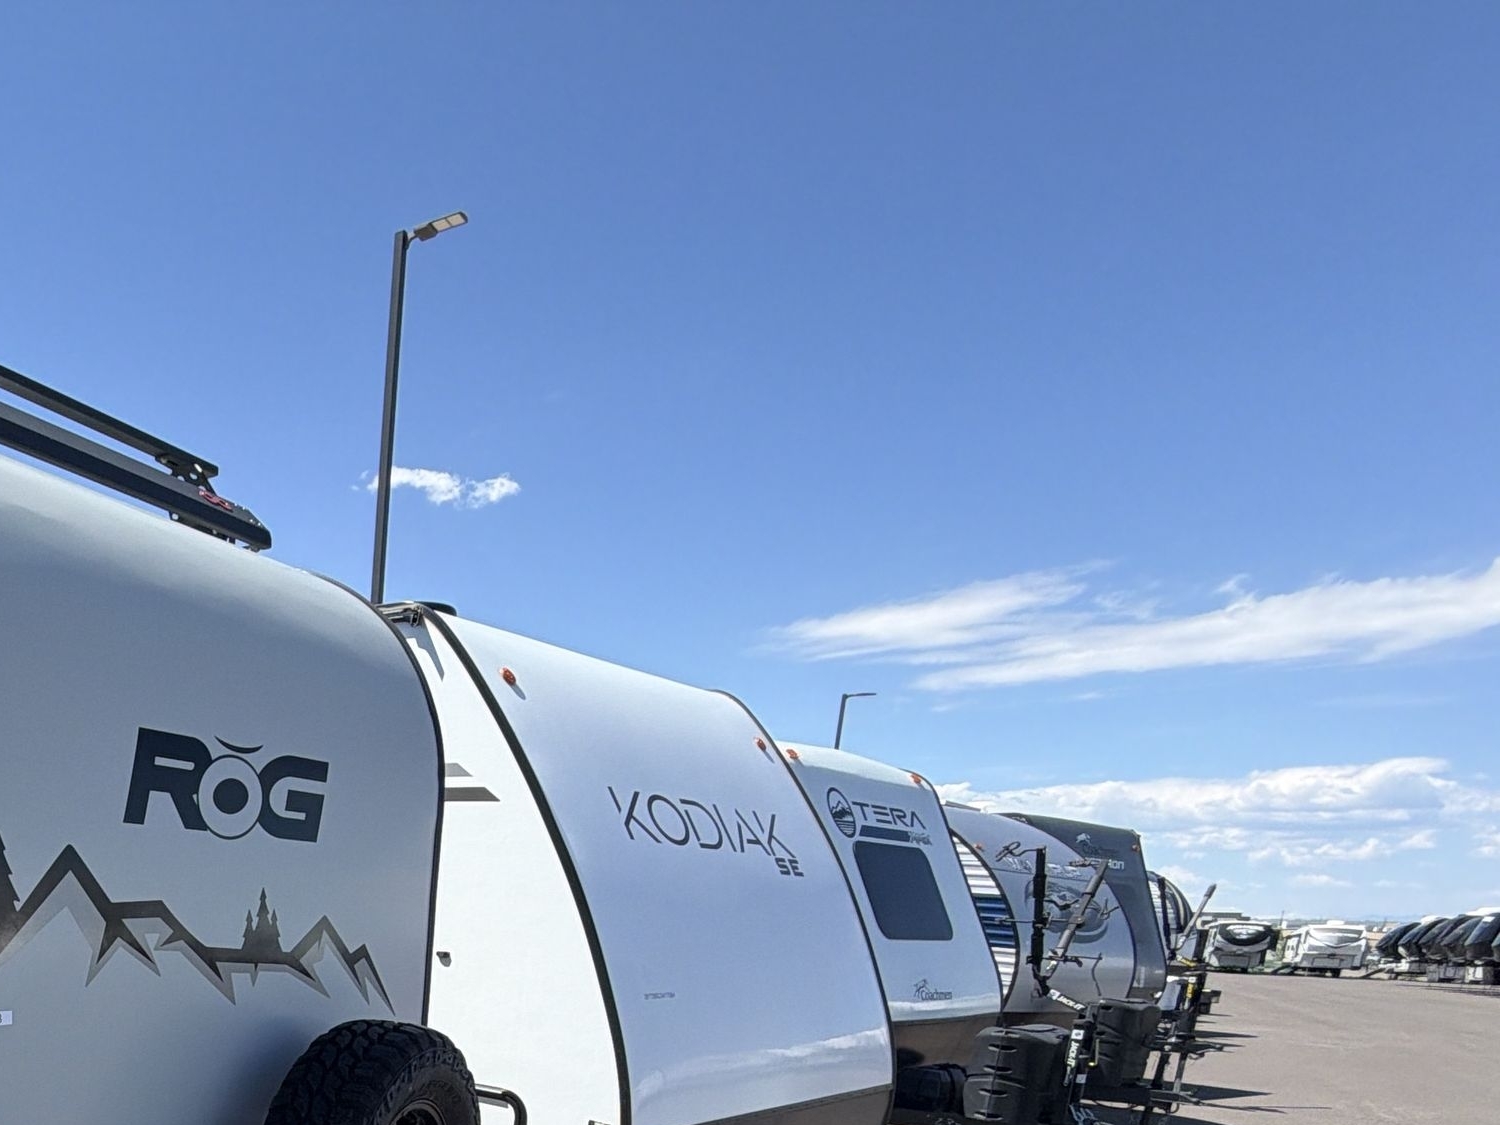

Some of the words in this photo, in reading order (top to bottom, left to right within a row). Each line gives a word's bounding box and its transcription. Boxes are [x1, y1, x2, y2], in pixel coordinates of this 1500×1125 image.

[123, 727, 329, 843] ROG
[607, 786, 796, 858] KODIAK
[774, 857, 804, 877] SE
